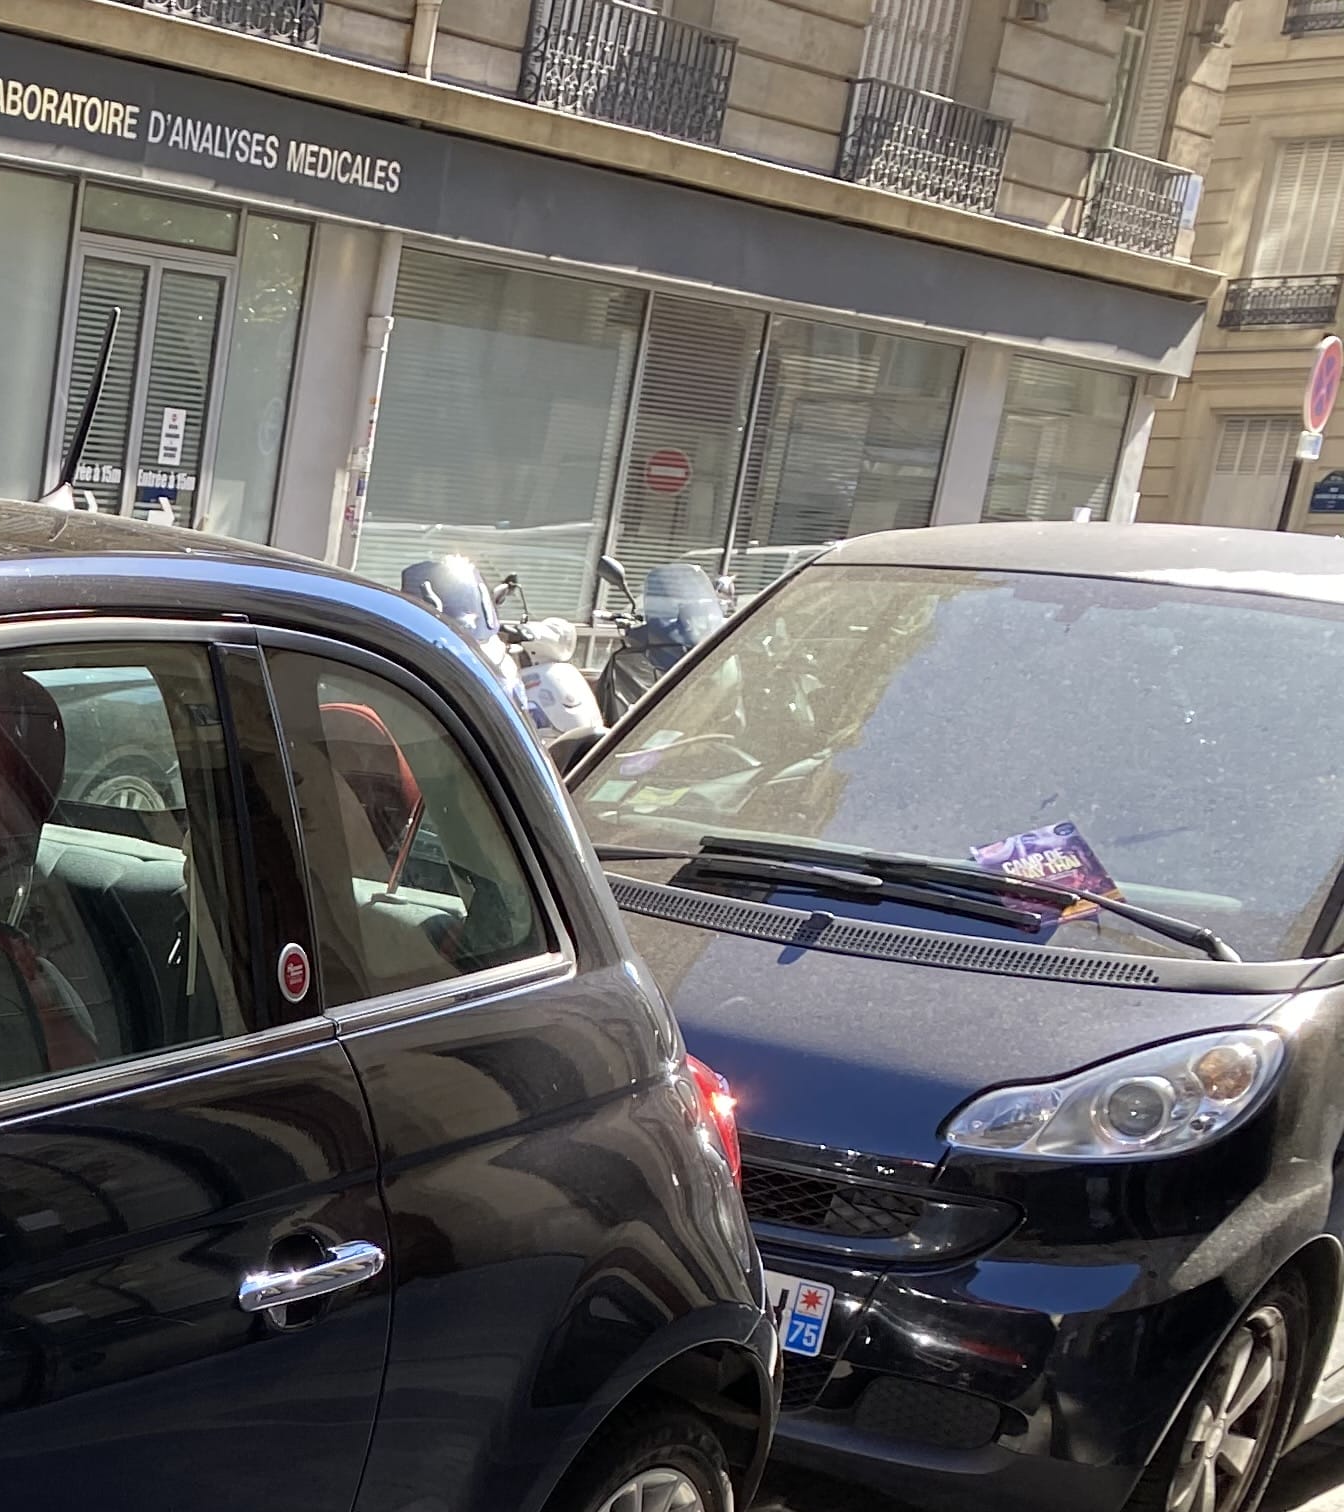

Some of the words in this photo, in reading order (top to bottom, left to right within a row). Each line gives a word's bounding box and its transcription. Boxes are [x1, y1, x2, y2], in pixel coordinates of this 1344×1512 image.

[147, 110, 279, 169] D'ANALYSES
[286, 141, 402, 195] MEDICALES
[137, 469, 167, 489] Entrée
[1002, 852, 1044, 876] CAMP
[1043, 847, 1065, 866] DE
[787, 1319, 820, 1348] 75
